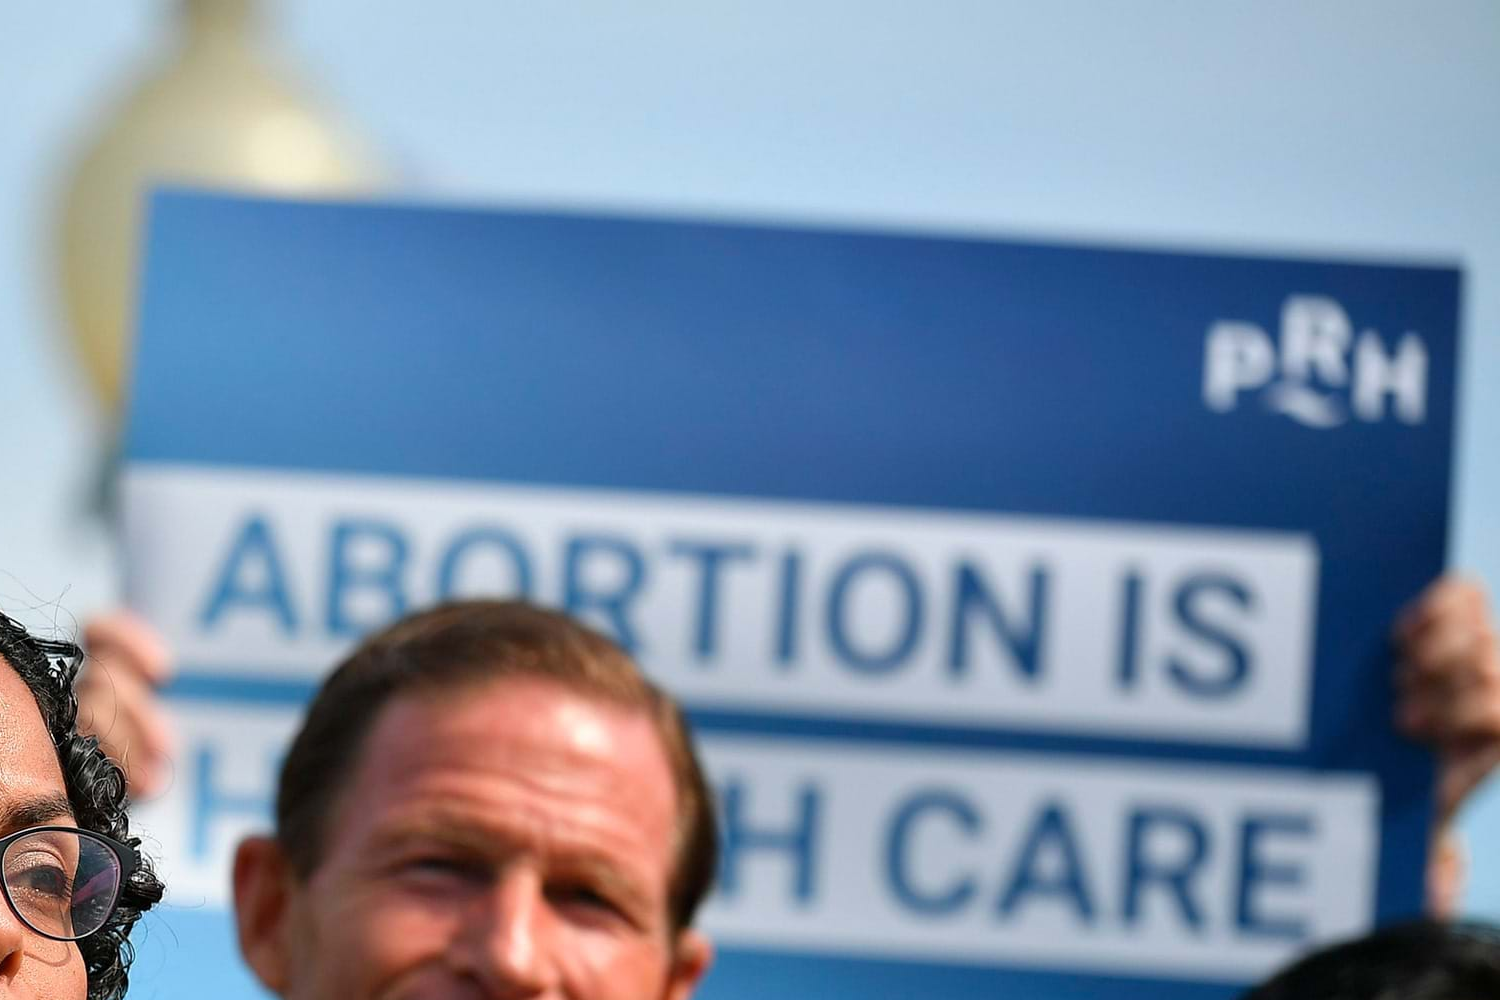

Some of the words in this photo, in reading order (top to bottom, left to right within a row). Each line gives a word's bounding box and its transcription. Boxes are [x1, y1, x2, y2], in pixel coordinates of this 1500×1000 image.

[1204, 294, 1429, 425] PRH
[200, 509, 1050, 682] ABORTION
[1118, 561, 1257, 700] IS
[882, 786, 1316, 938] CARE
